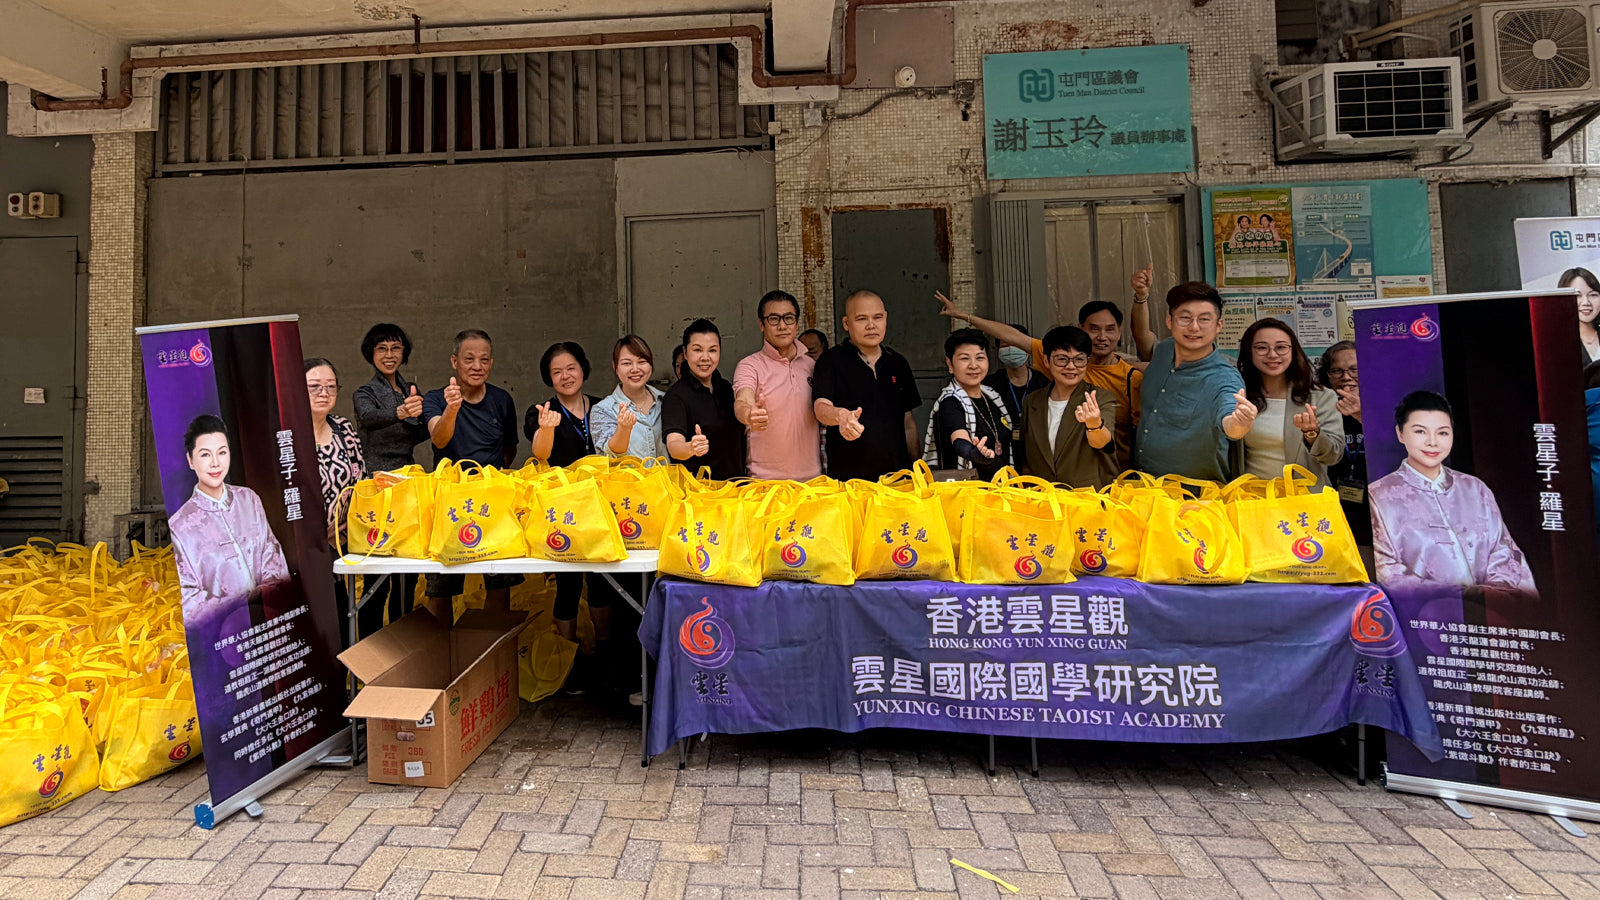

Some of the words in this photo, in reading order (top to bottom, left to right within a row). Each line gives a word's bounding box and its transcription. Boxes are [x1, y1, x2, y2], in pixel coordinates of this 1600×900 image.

[1058, 69, 1139, 87] 屯門區議會
[1119, 86, 1145, 95] Council
[993, 114, 1107, 152] 謝玉玲
[926, 595, 1128, 636] 香港雲星觀
[928, 638, 969, 650] HONG
[972, 638, 1012, 650] KONG
[1014, 638, 1044, 649] YUN
[1047, 638, 1084, 650] XING
[1088, 638, 1127, 650] GUAN
[851, 655, 1222, 707] 雲星國際國學研究院
[696, 696, 732, 704] YUNXING
[852, 699, 940, 717] YUNXING
[945, 704, 1035, 722] CHINESE
[1038, 707, 1115, 726] TAOIST
[1119, 711, 1225, 729] ACADEMY
